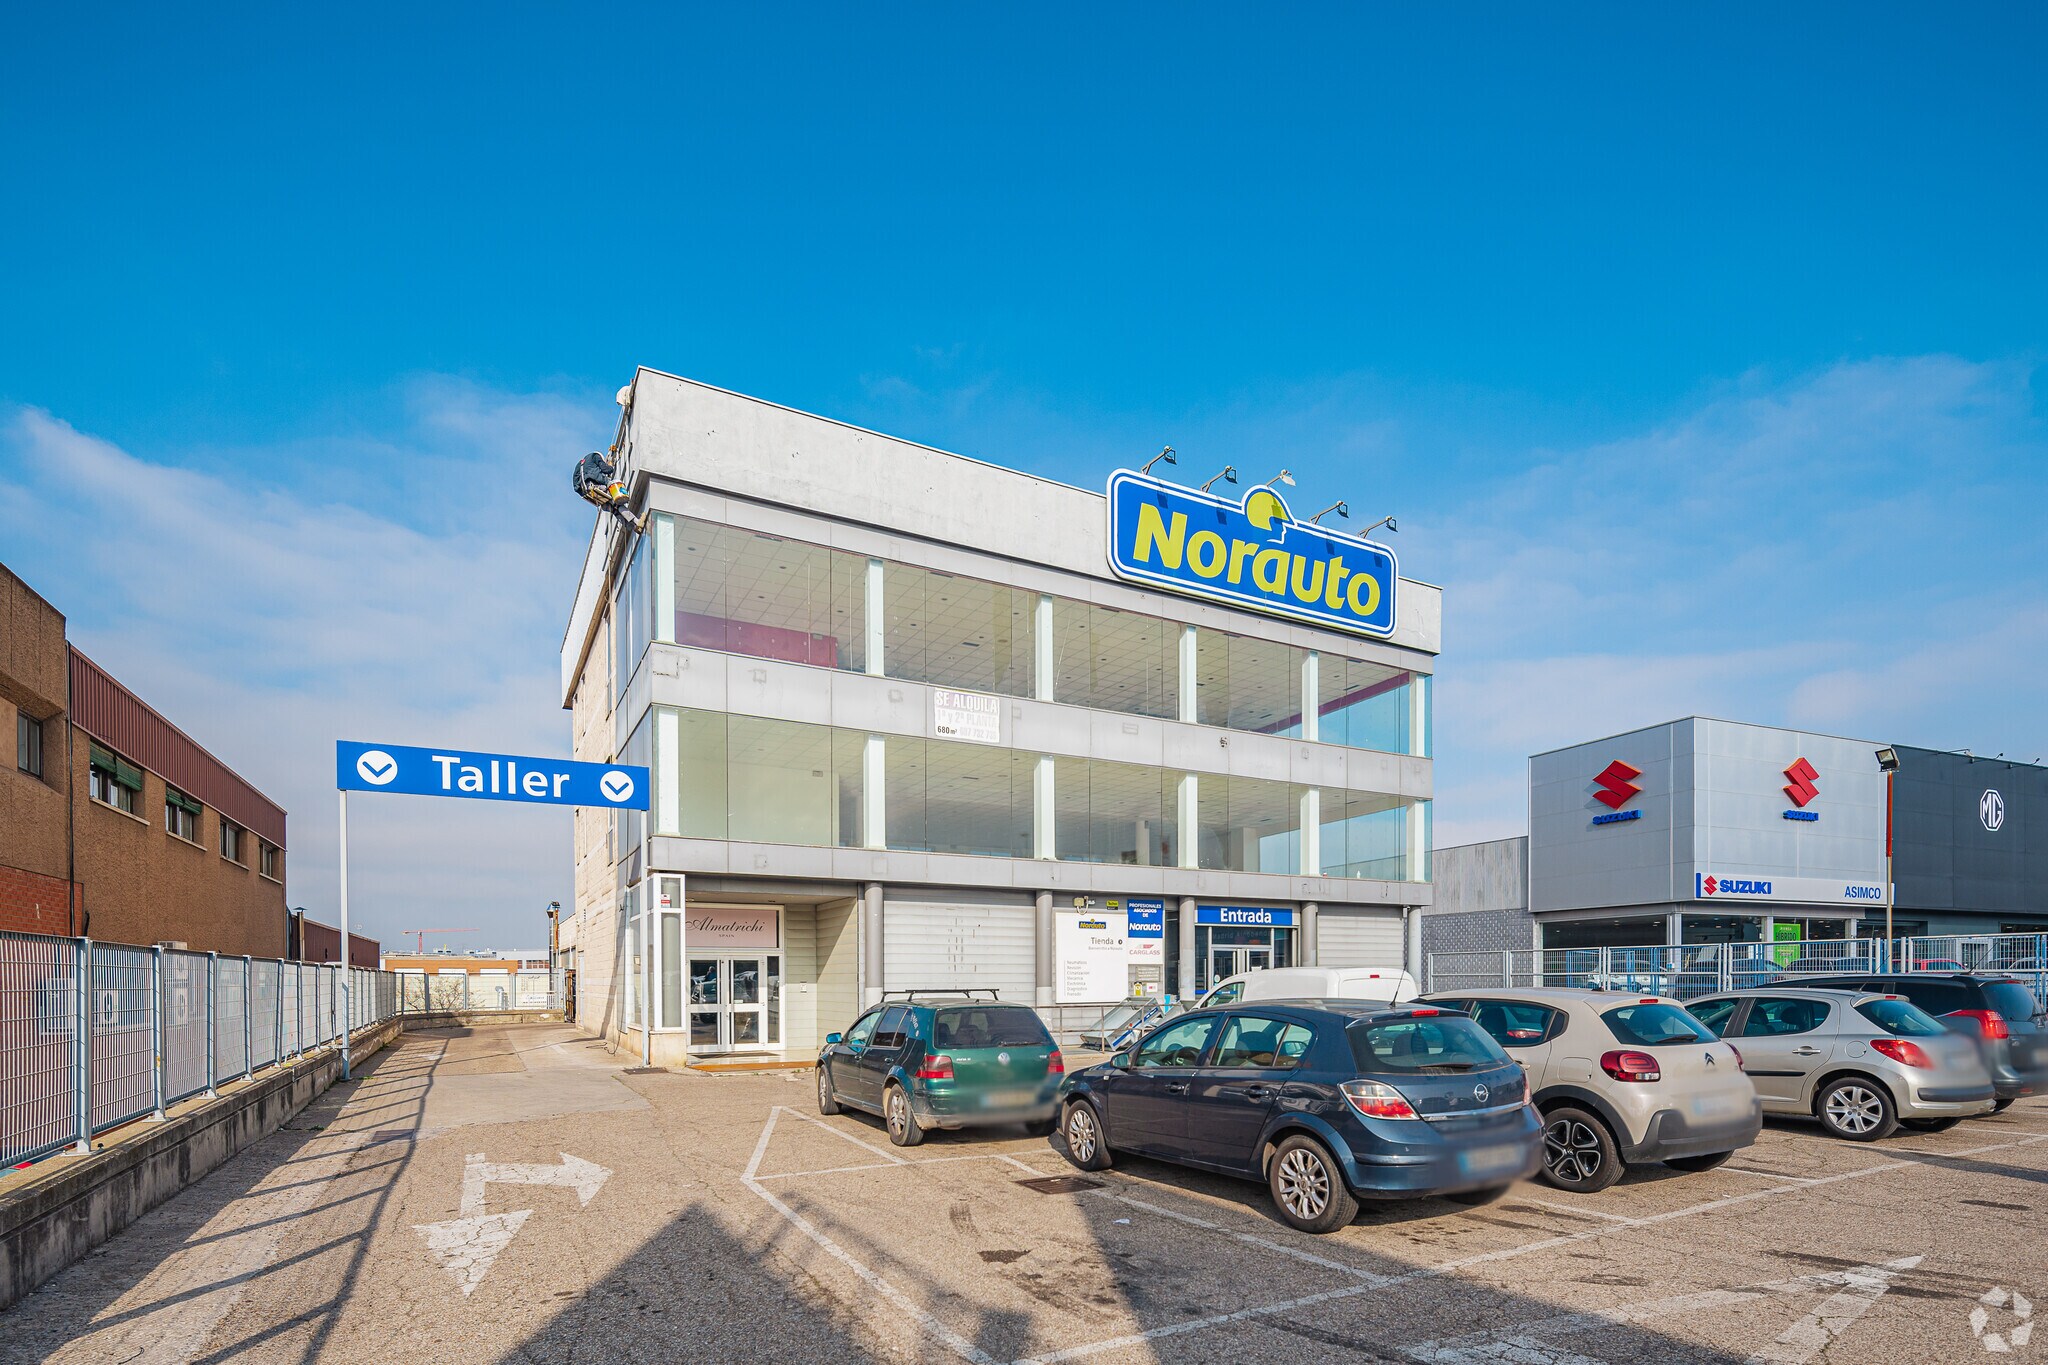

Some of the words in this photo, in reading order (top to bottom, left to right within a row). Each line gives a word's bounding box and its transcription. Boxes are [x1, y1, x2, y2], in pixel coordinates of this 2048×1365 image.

[1133, 502, 1381, 616] Norauto
[936, 691, 950, 706] SE
[953, 694, 998, 713] ALQUILA
[966, 713, 997, 728] PLANTA
[937, 725, 950, 734] 680
[431, 755, 570, 798] Taller
[1592, 809, 1642, 825] SUZUKI
[1782, 809, 1819, 822] SUZUKI
[1982, 792, 2002, 828] MG
[1719, 879, 1772, 895] SUZUKI
[1844, 886, 1881, 900] ASIMCO
[1220, 907, 1272, 924] Entrada
[686, 916, 766, 932] Almatrichi
[1129, 923, 1162, 932] Norauto
[1090, 936, 1114, 945] Tienda
